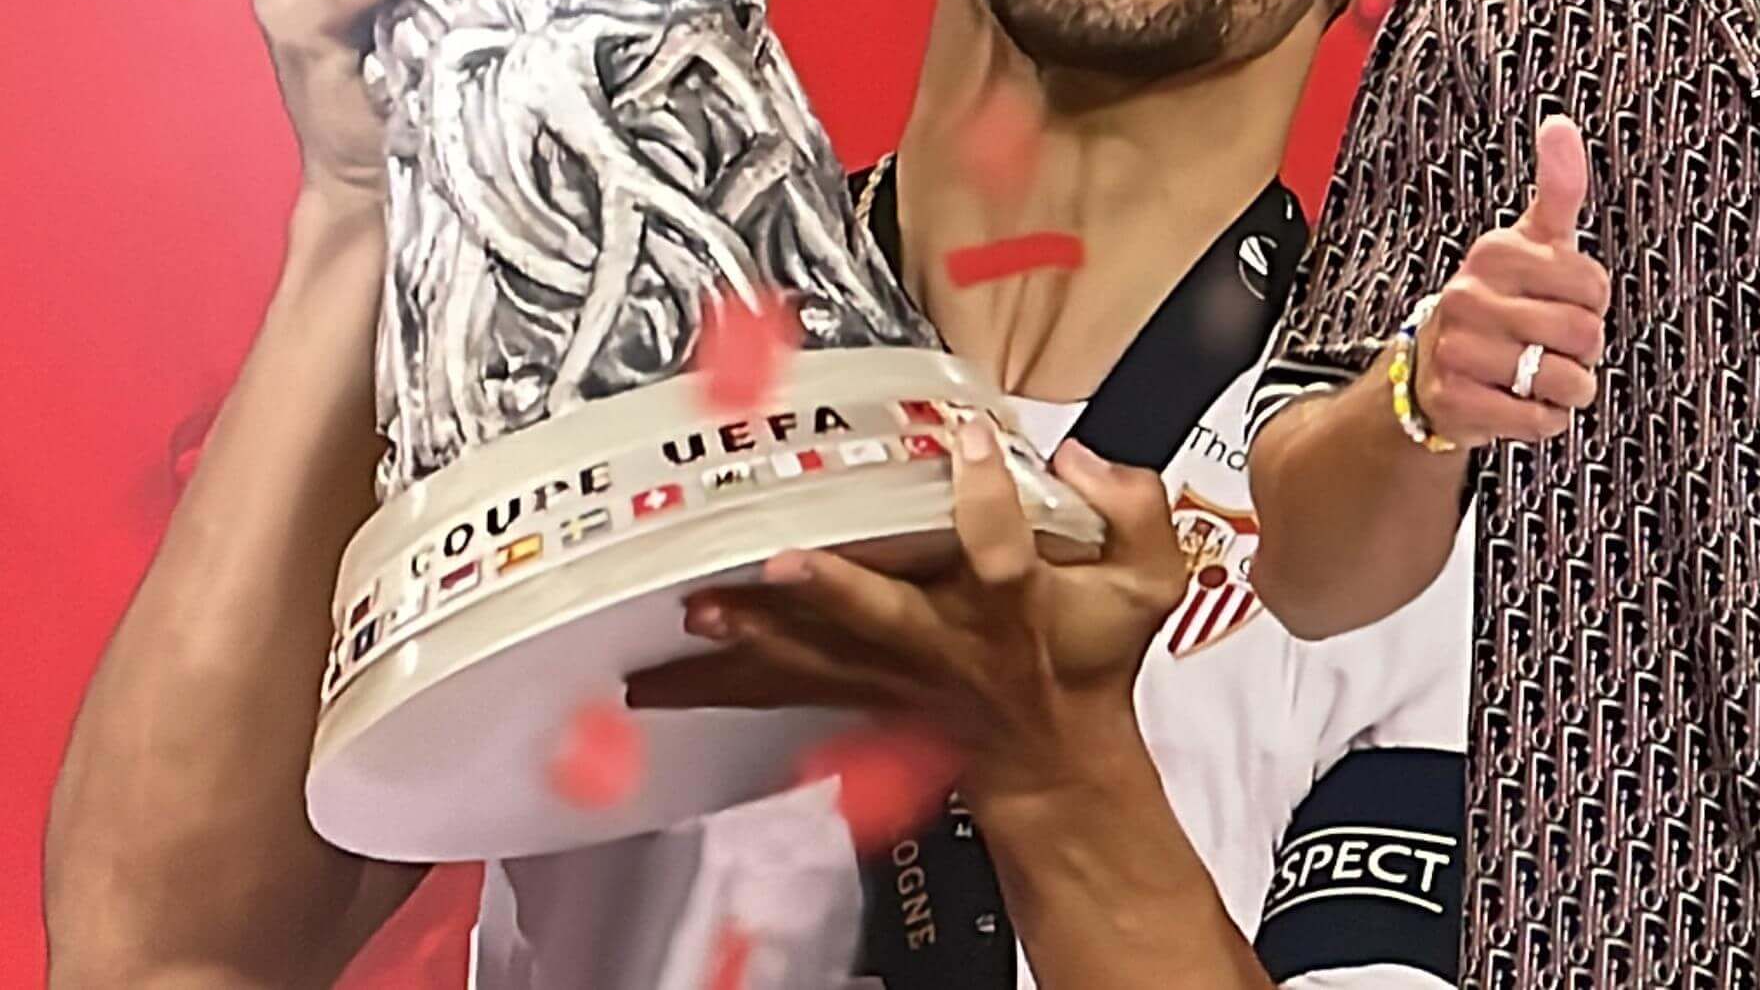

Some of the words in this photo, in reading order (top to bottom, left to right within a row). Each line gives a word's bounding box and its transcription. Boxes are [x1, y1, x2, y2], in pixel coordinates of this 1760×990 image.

[411, 462, 613, 578] COUPE
[662, 406, 852, 466] UEFA
[1270, 840, 1450, 903] SPECT
